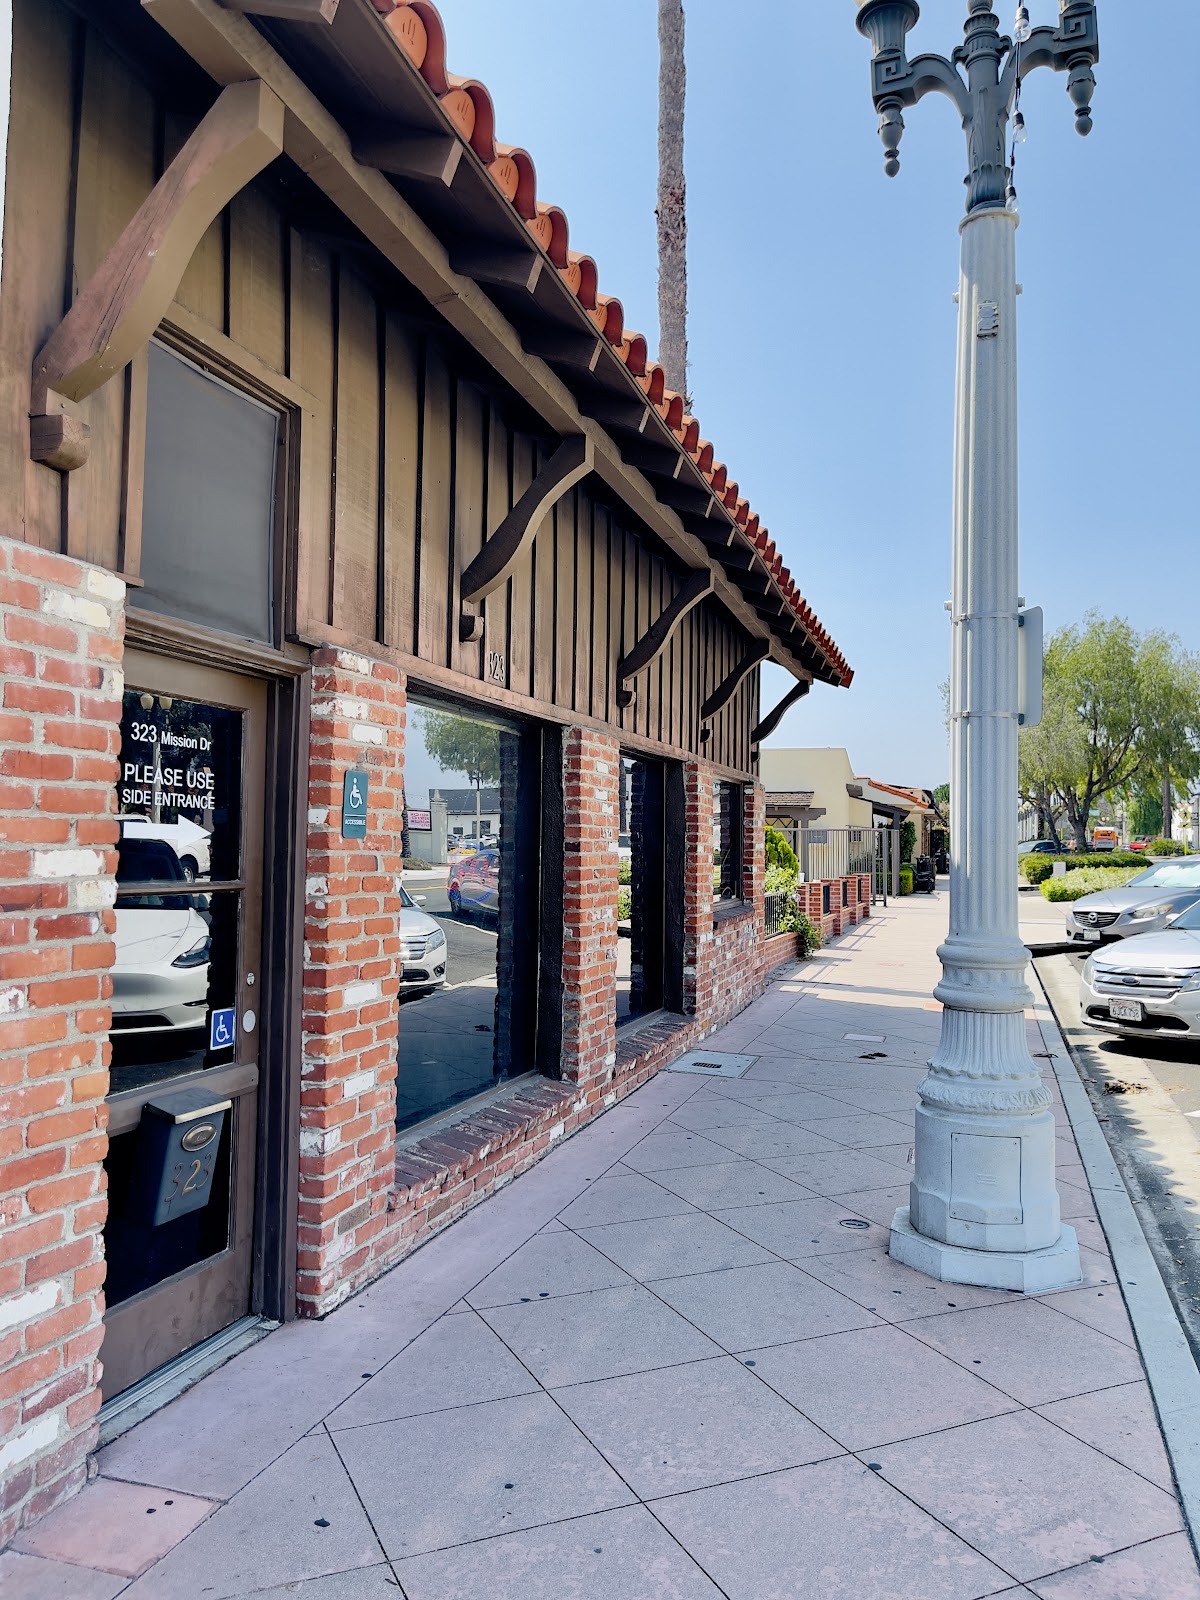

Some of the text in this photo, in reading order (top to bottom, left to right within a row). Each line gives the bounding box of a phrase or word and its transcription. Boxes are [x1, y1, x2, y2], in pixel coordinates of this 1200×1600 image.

[130, 721, 212, 751] 323 Mission Dr
[123, 763, 215, 790] PLEASE USE
[121, 788, 216, 810] SIDE ENTRANCE
[164, 1151, 212, 1202] 323
